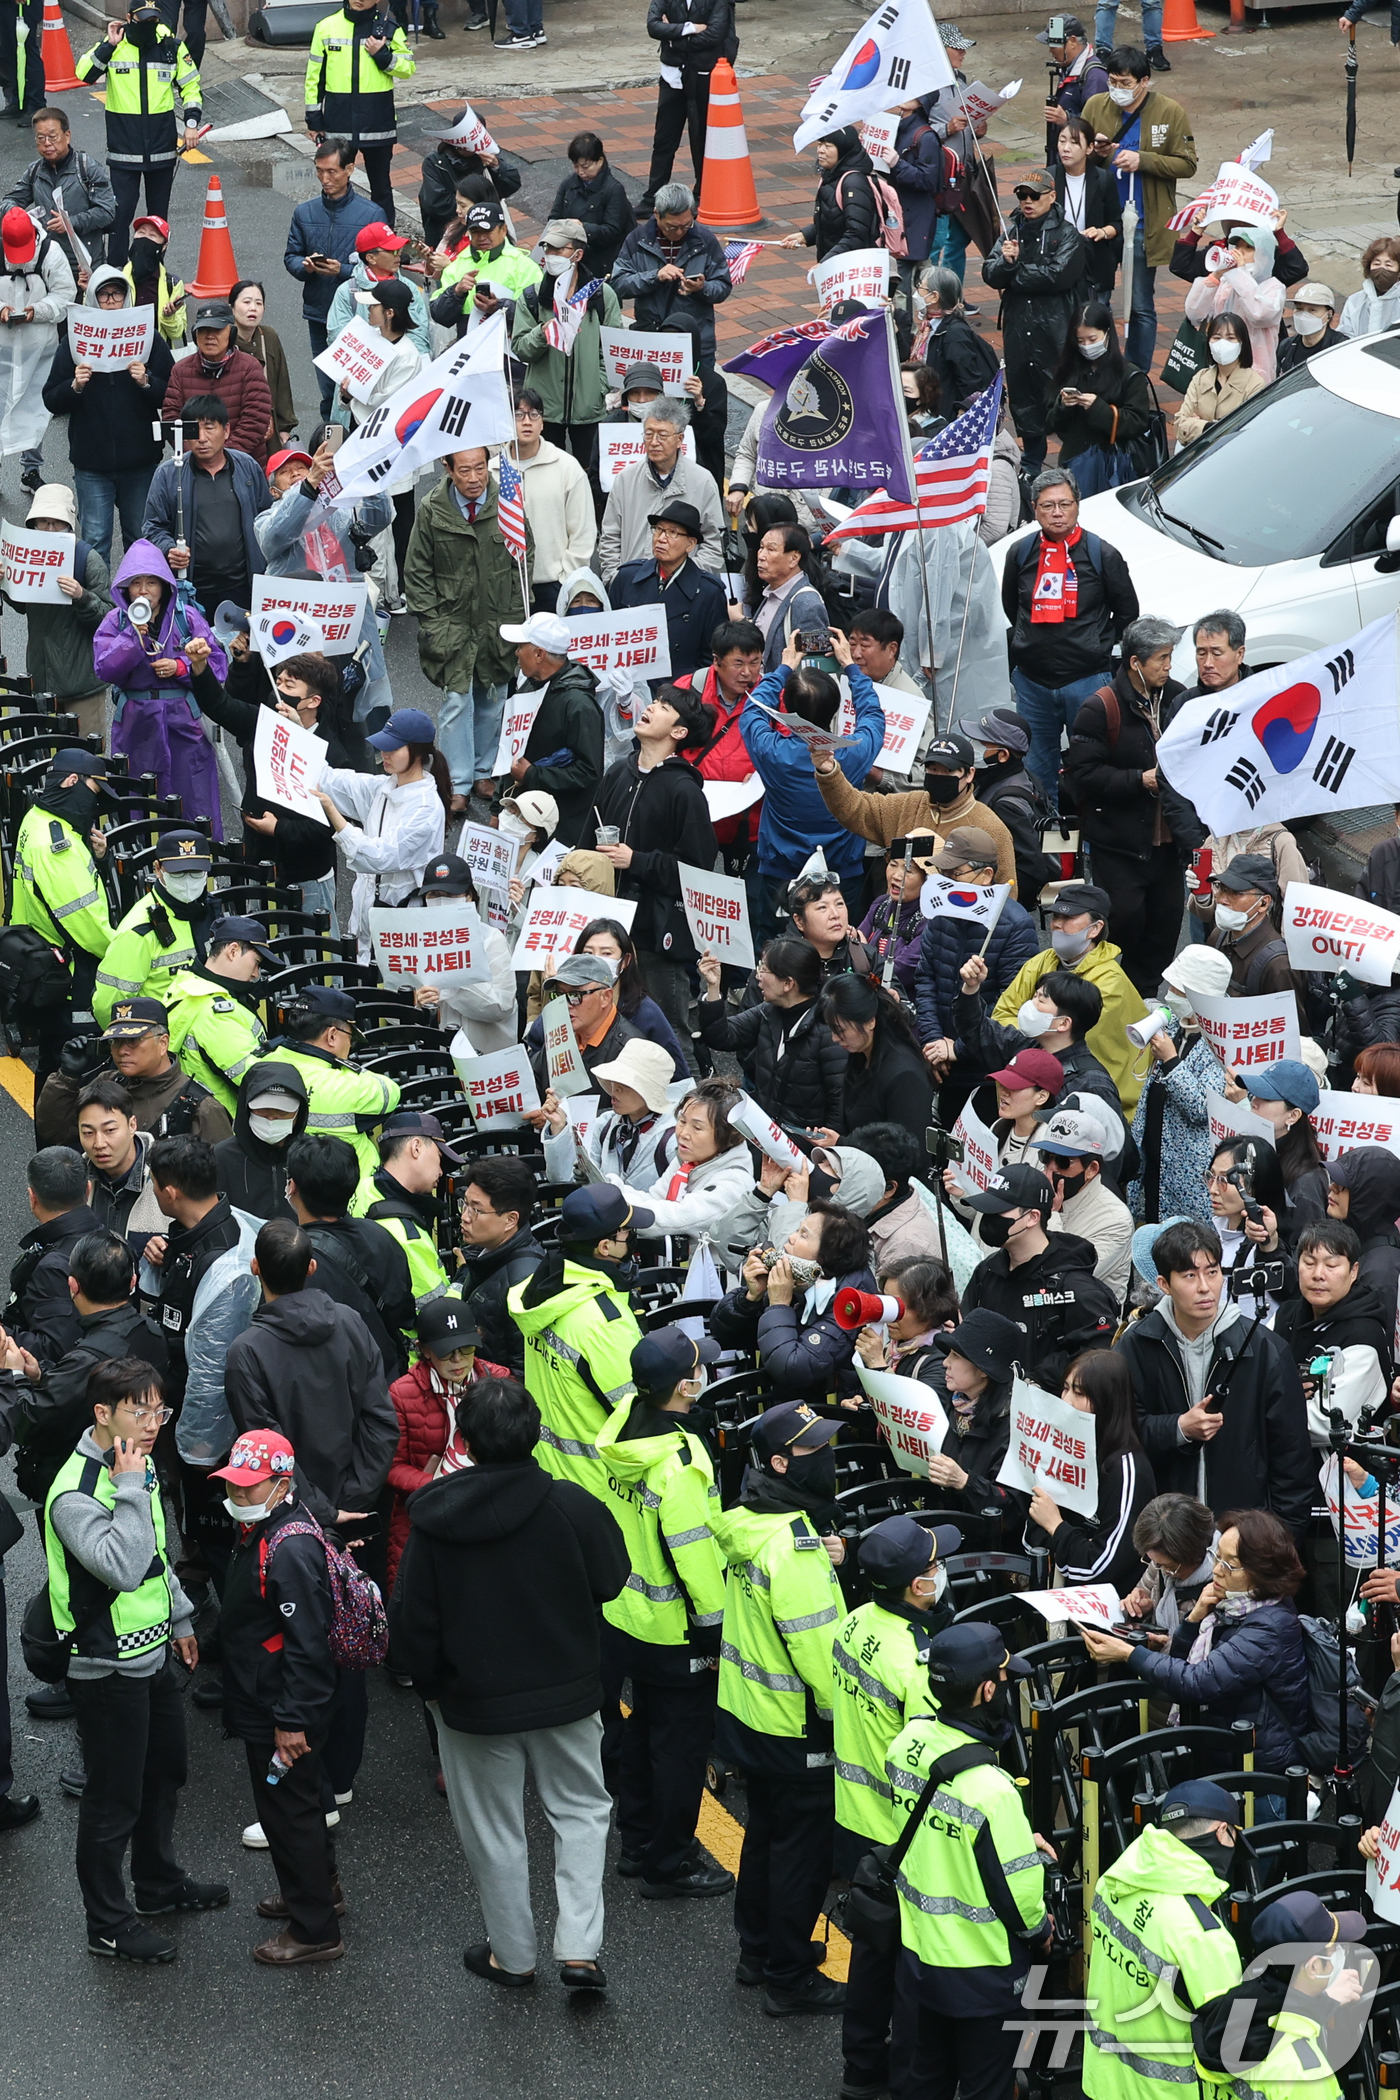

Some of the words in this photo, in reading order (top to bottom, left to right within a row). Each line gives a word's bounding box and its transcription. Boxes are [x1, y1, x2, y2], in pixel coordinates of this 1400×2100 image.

[468, 207, 491, 220] KOREA
[1233, 195, 1271, 216] 사퇴!
[848, 283, 882, 299] 사퇴!
[73, 322, 147, 340] 권영세·권성동
[75, 340, 104, 358] 즉각
[107, 340, 144, 358] 사퇴!
[341, 332, 385, 370] 권영세·권성동
[609, 345, 684, 364] 권영세·권성동
[332, 347, 348, 368] 즉각
[347, 359, 373, 385] 사퇴!
[6, 566, 46, 587] OUT!
[613, 646, 657, 669] 사퇴!
[270, 723, 292, 801] 강제단일화
[289, 752, 308, 800] OUT!
[469, 837, 492, 856] 쌍권
[467, 853, 489, 872] 당원
[491, 860, 507, 879] 투표
[685, 887, 741, 921] 강제단일화
[379, 927, 470, 948] 권영세·권성동
[696, 919, 730, 946] OUT!
[1292, 906, 1396, 942] 강제단일화
[524, 932, 558, 952] 즉각
[1312, 935, 1366, 962] OUT!
[388, 954, 418, 974] 즉각
[423, 950, 471, 973] 사퇴!
[551, 1049, 575, 1079] 사퇴!
[1231, 1040, 1285, 1067] 사퇴!
[474, 1092, 524, 1120] 사퇴!
[896, 1430, 930, 1463] 사퇴!
[1016, 1410, 1086, 1460] 권영세·권성동
[1018, 1440, 1042, 1474] 즉각
[1044, 1456, 1086, 1490] 사퇴!
[843, 1615, 882, 1667] 경찰
